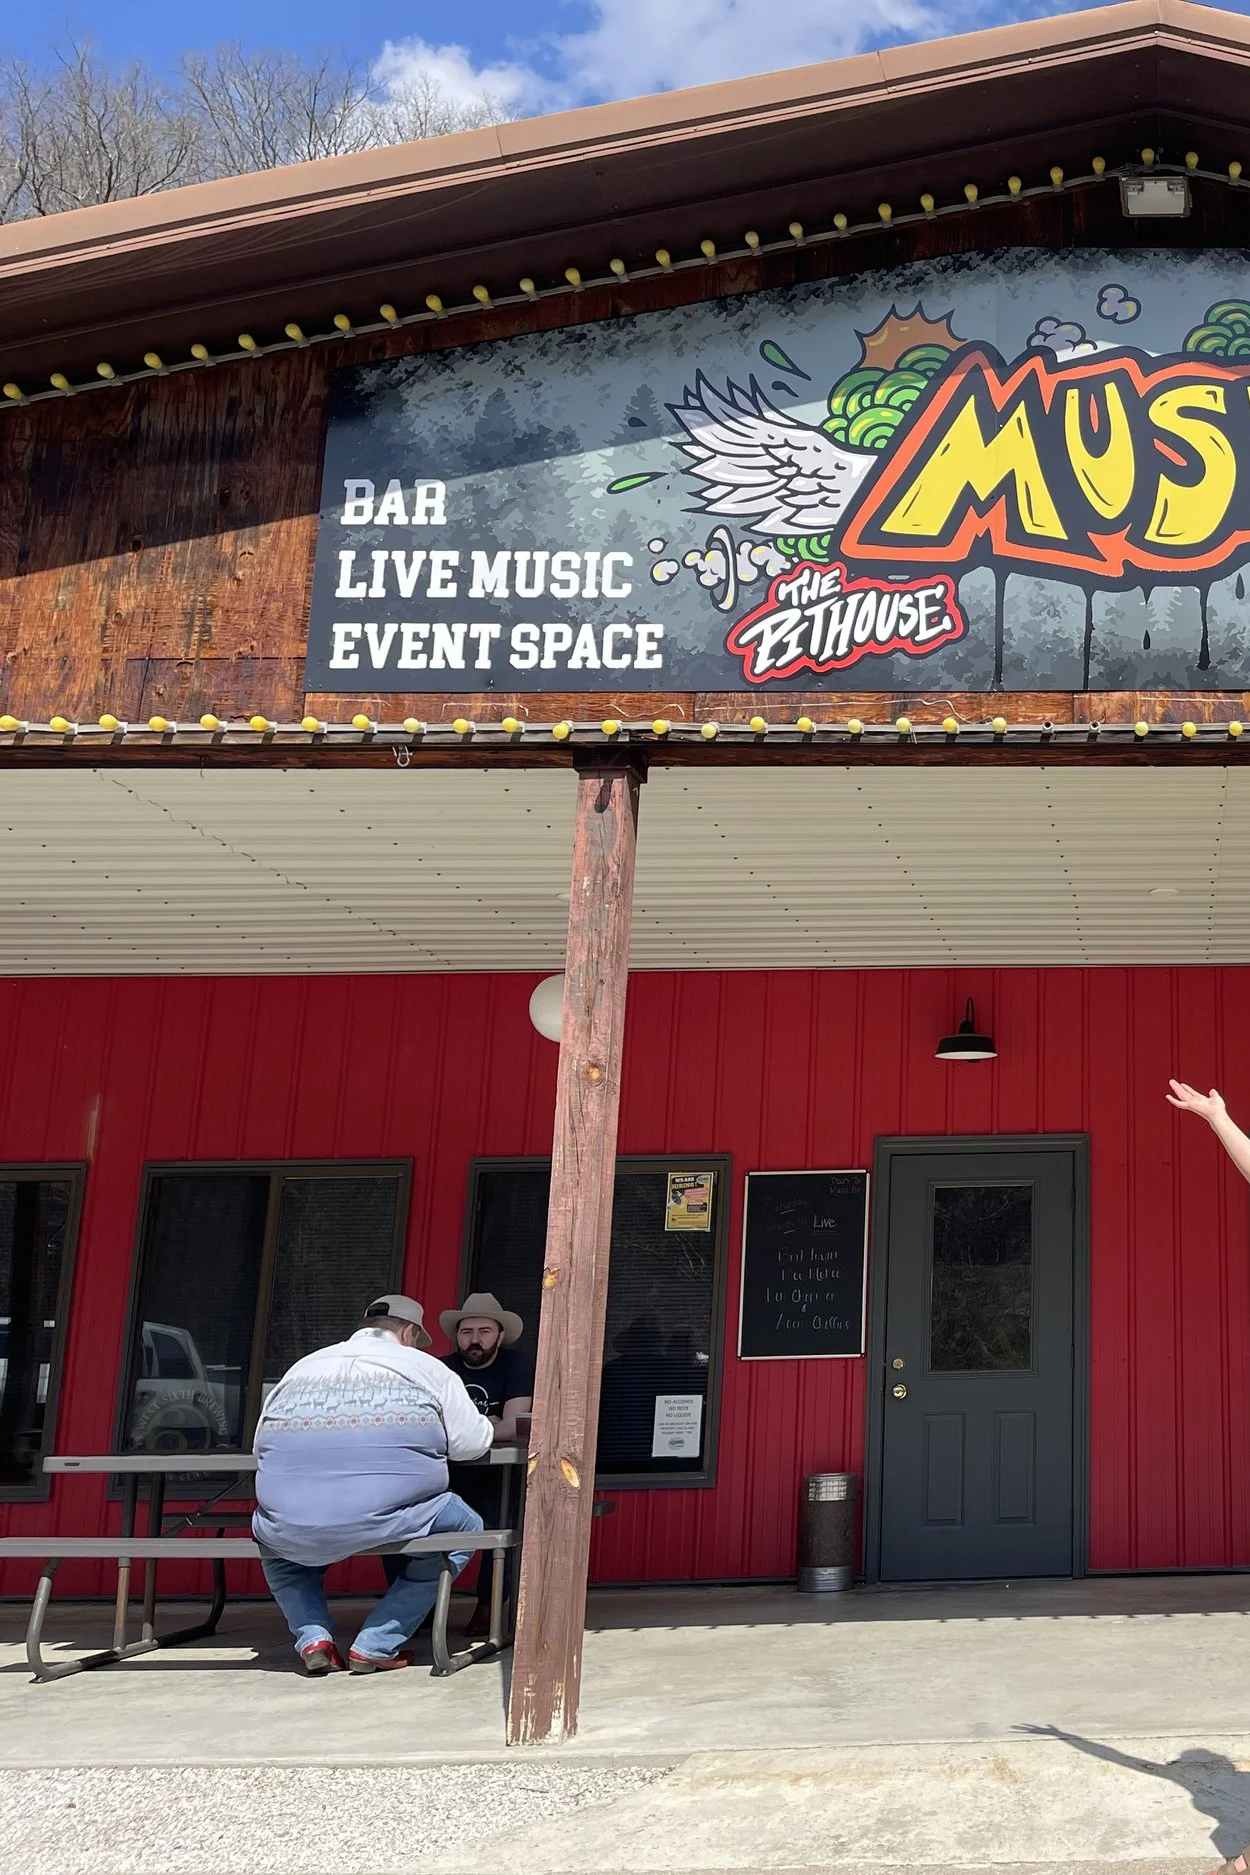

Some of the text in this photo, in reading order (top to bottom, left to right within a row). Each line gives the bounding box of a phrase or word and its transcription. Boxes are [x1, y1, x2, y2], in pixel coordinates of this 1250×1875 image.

[340, 478, 447, 526] BAR
[334, 549, 634, 599] LIVE MUSIC
[778, 568, 842, 606] THE
[329, 622, 664, 670] EVENT SPACE
[813, 1214, 838, 1229] Live
[162, 1389, 196, 1403] SIXTH
[197, 1392, 229, 1436] BREWING
